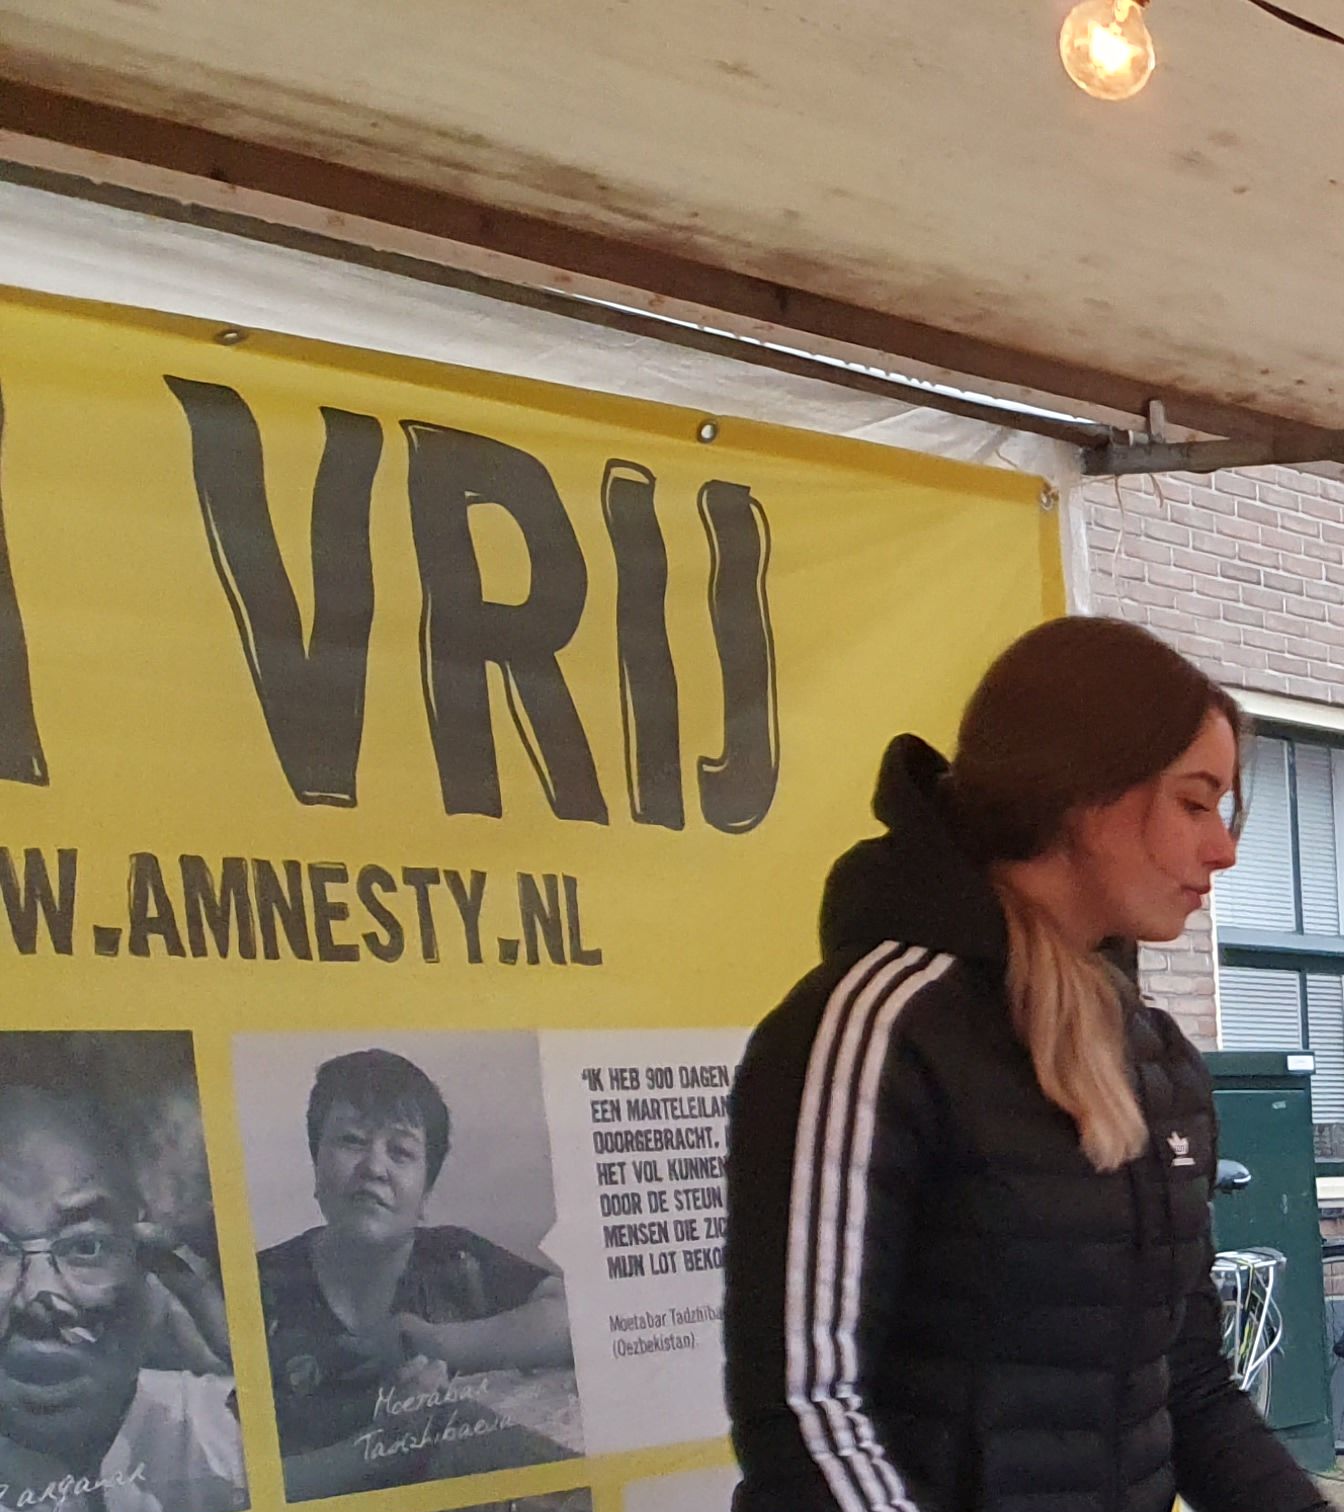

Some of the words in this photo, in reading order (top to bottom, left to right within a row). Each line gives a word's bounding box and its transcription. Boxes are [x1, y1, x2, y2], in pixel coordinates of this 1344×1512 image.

[163, 375, 780, 834] VRIJ
[609, 1066, 640, 1091] HEB
[645, 1066, 674, 1090] 900
[678, 1064, 730, 1090] DAGEN
[591, 1099, 622, 1123] EEN
[626, 1095, 733, 1122] MARTELEILAN
[593, 1129, 720, 1155] DOORGEBRACHT.
[598, 1161, 626, 1187] HET
[633, 1159, 663, 1184] VOL
[600, 1191, 643, 1217] DOOR
[647, 1190, 669, 1214] DE
[674, 1186, 723, 1212] STEUN
[603, 1221, 669, 1249] MENSEN
[673, 1219, 700, 1243] DIE
[704, 1216, 728, 1241] ZIC
[607, 1254, 645, 1280] MIJN
[650, 1251, 677, 1276] LOT
[683, 1248, 726, 1272] BEKO
[609, 1307, 667, 1334] Moetabar
[670, 1305, 723, 1328] Tadzhiba
[613, 1331, 697, 1360] (Oezbekistan)
